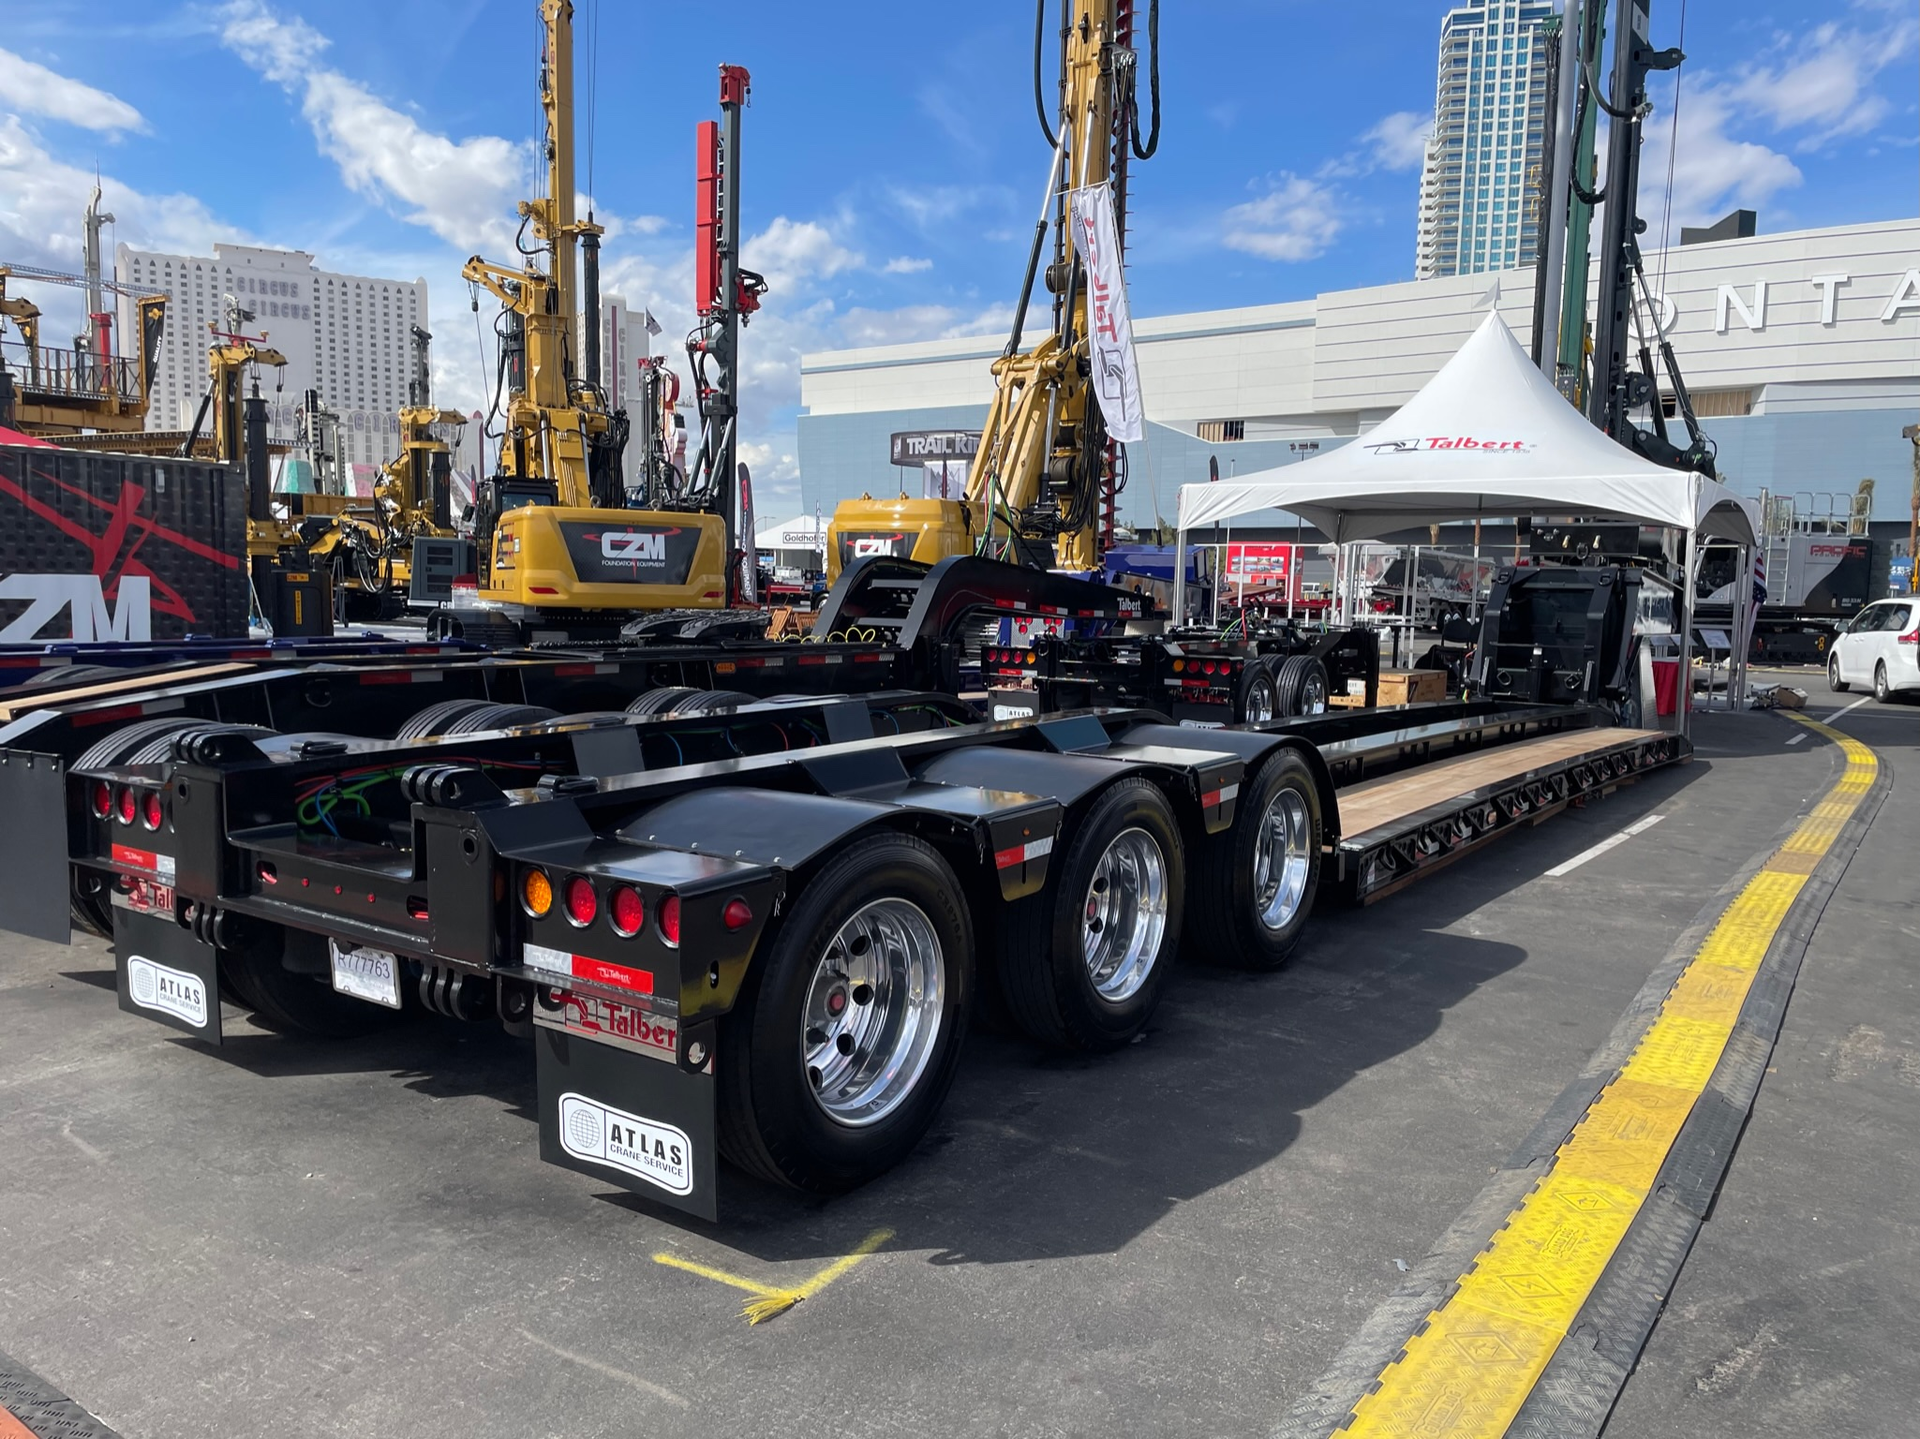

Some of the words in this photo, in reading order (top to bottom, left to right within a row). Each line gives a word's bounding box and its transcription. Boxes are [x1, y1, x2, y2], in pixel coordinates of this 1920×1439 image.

[237, 277, 299, 298] CIRCUS
[249, 300, 311, 320] CIRCUS
[1425, 437, 1524, 449] Talbert
[602, 532, 665, 560] CZM
[784, 534, 825, 542] Goldhofr
[855, 539, 892, 558] CZM
[0, 573, 151, 643] ZM
[1117, 597, 1141, 610] Talbert
[1009, 710, 1030, 718] ATLAS
[338, 952, 390, 979] R777763
[159, 992, 178, 1006] CRANE
[178, 998, 202, 1014] SERVICE
[160, 977, 200, 1005] ATLAS
[602, 1002, 676, 1047] Talber
[611, 1123, 682, 1166] ATLAS
[610, 1143, 641, 1162] CRANE
[644, 1155, 684, 1178] SERVICE
[1424, 1407, 1449, 1434] GUARD
[1446, 1390, 1462, 1408] DOG
